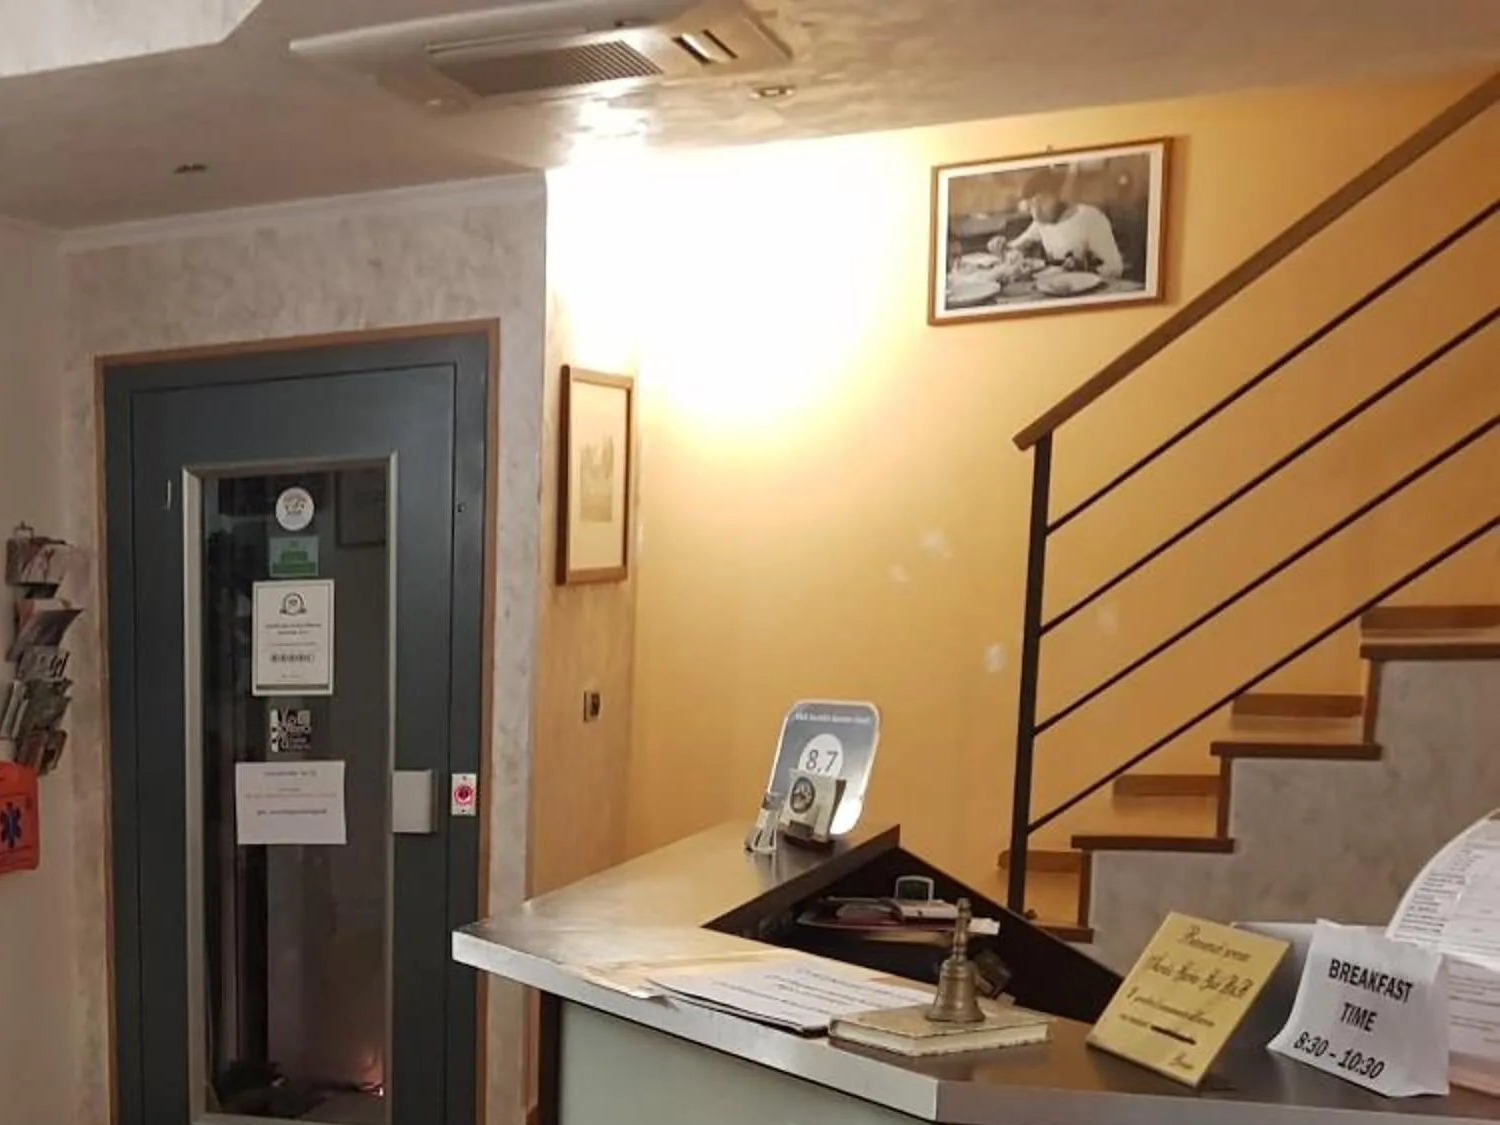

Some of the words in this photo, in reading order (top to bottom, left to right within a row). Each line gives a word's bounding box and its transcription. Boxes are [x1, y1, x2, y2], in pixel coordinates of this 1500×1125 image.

[1329, 958, 1413, 1003] BREAKFAST
[1341, 1002, 1378, 1032] TIME
[1293, 1032, 1329, 1057] 8:30
[1338, 1048, 1386, 1079] 10:30
